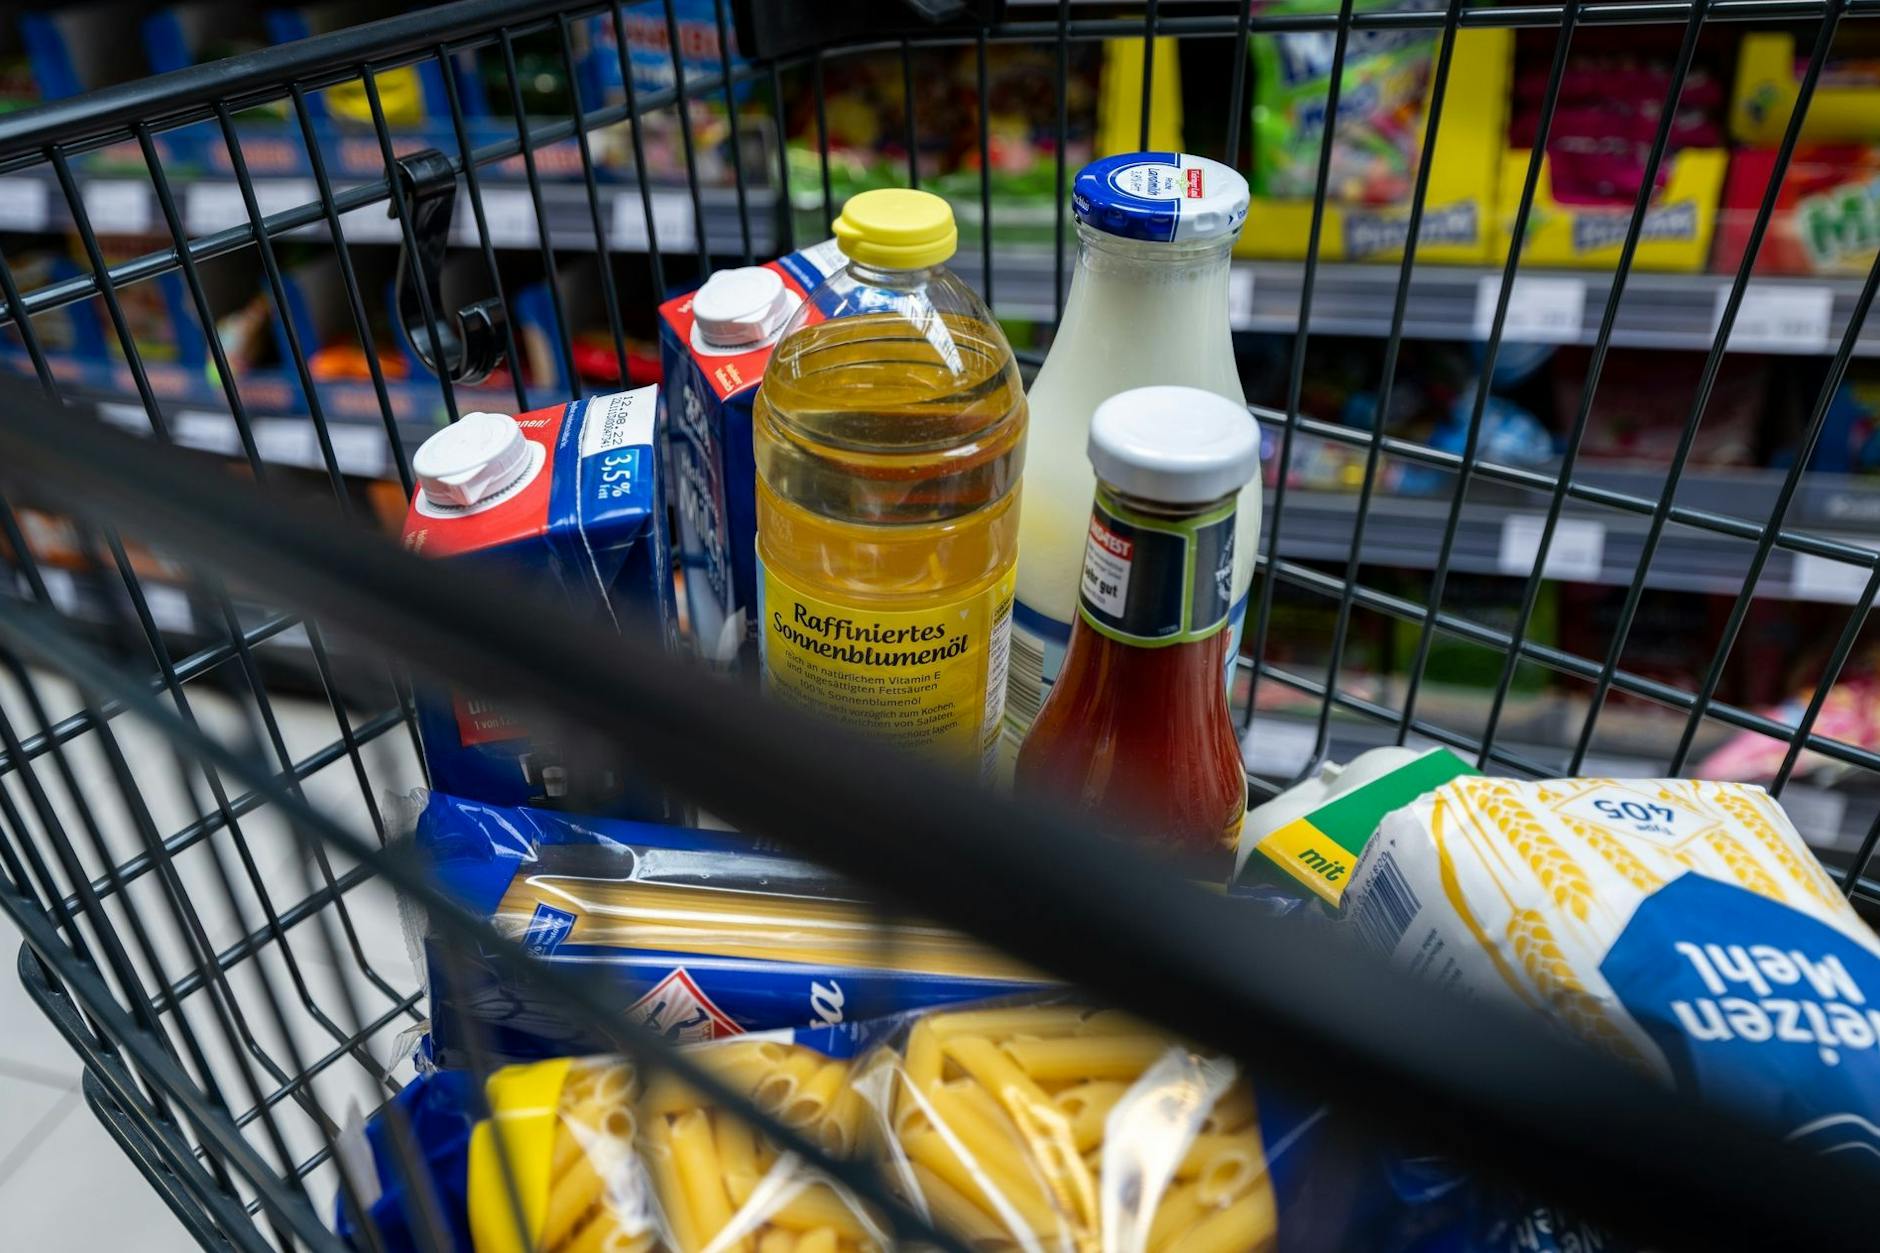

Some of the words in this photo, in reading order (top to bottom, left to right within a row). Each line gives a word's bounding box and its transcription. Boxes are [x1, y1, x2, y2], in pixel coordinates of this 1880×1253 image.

[612, 396, 633, 446] 12.08.22
[601, 454, 631, 498] 3,5%
[1100, 579, 1118, 599] gut
[773, 611, 969, 666] Sonnenblumenöl
[793, 602, 946, 644] Raffiniertes
[785, 650, 805, 667] reich
[807, 663, 818, 672] an
[821, 667, 885, 684] natürlichem
[888, 674, 931, 685] Vitamin
[934, 671, 942, 680] E
[786, 661, 802, 675] und
[804, 671, 876, 694] ungesättigten
[879, 682, 938, 695] Fettsäuren
[828, 690, 922, 707] Sonnenblumenöl
[850, 708, 897, 720] vorzüglich
[899, 709, 919, 718] zum
[894, 720, 914, 728] von
[1593, 799, 1675, 824] 405
[1298, 848, 1345, 881] mit
[1674, 941, 1866, 1005] Mehl
[1670, 997, 1880, 1067] eizen
